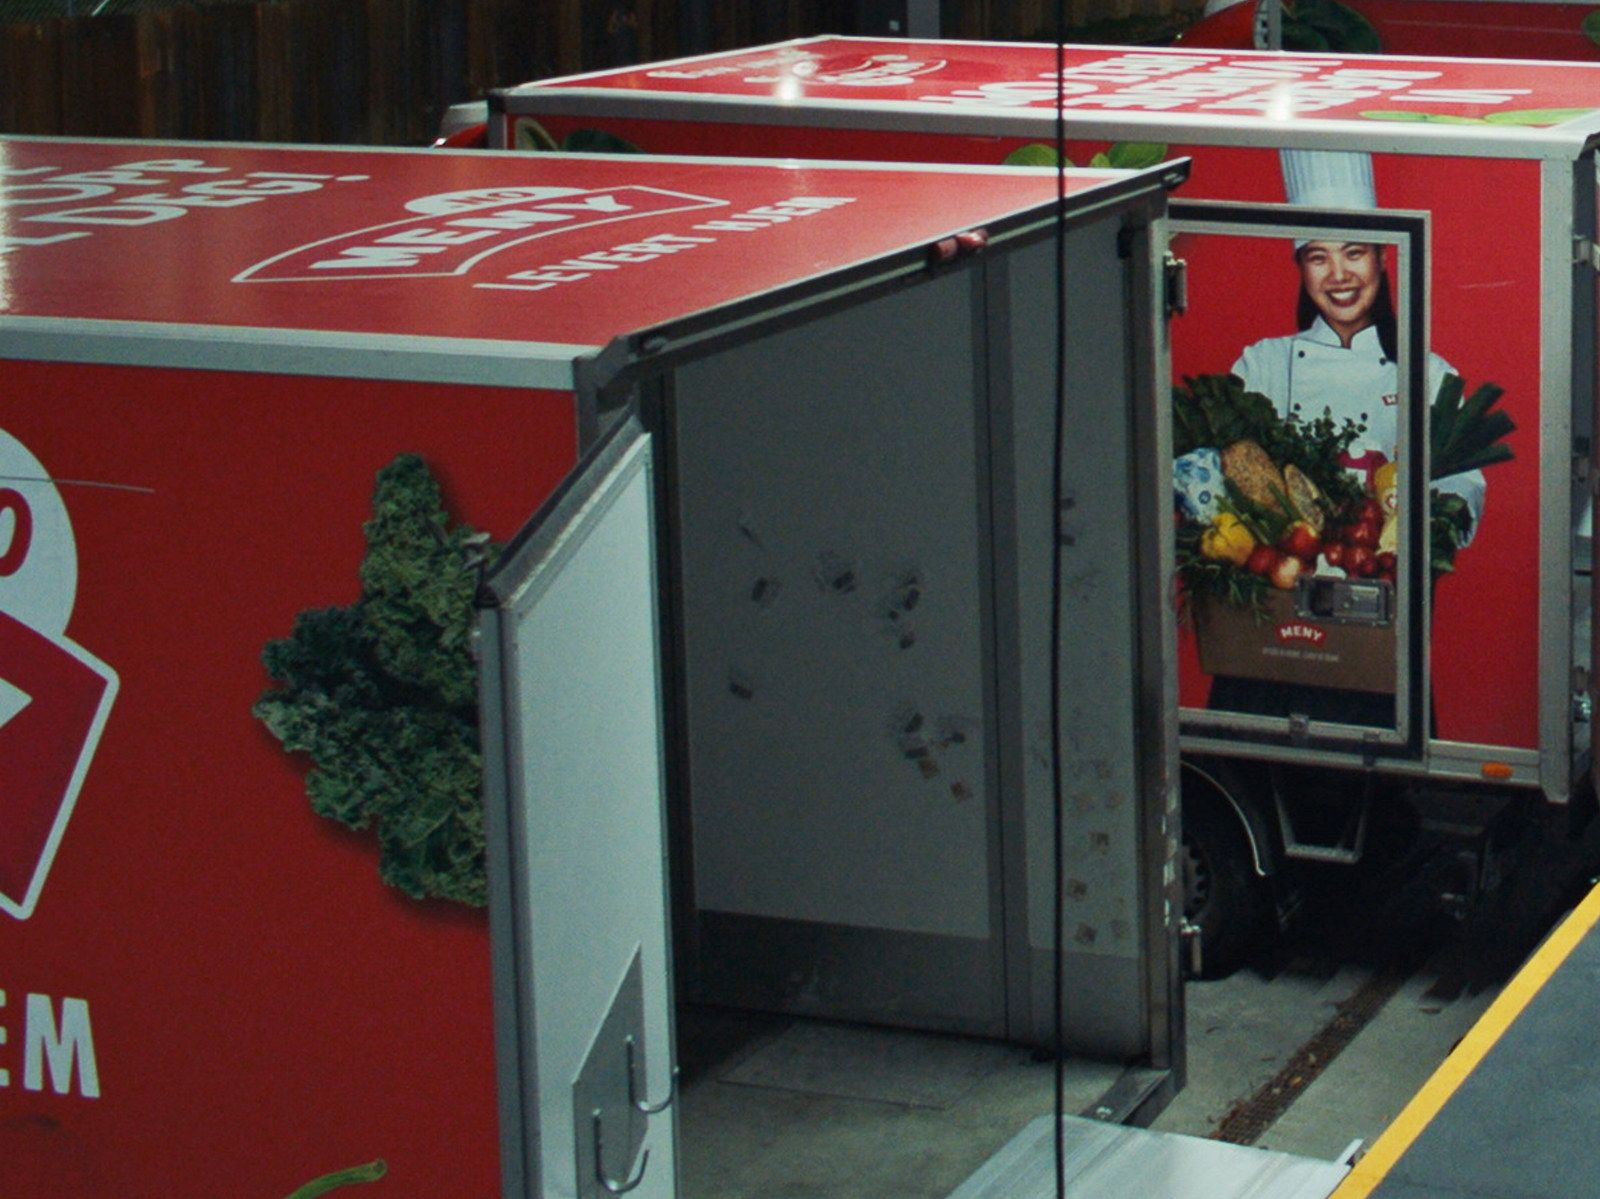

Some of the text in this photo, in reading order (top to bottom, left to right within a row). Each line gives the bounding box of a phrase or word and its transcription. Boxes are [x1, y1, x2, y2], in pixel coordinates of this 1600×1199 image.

[1060, 60, 1344, 110] VARENE
[20, 171, 372, 227] DEG!
[309, 193, 633, 271] MENY
[472, 196, 858, 290] LEVERT HJEM
[1280, 625, 1322, 641] MENY
